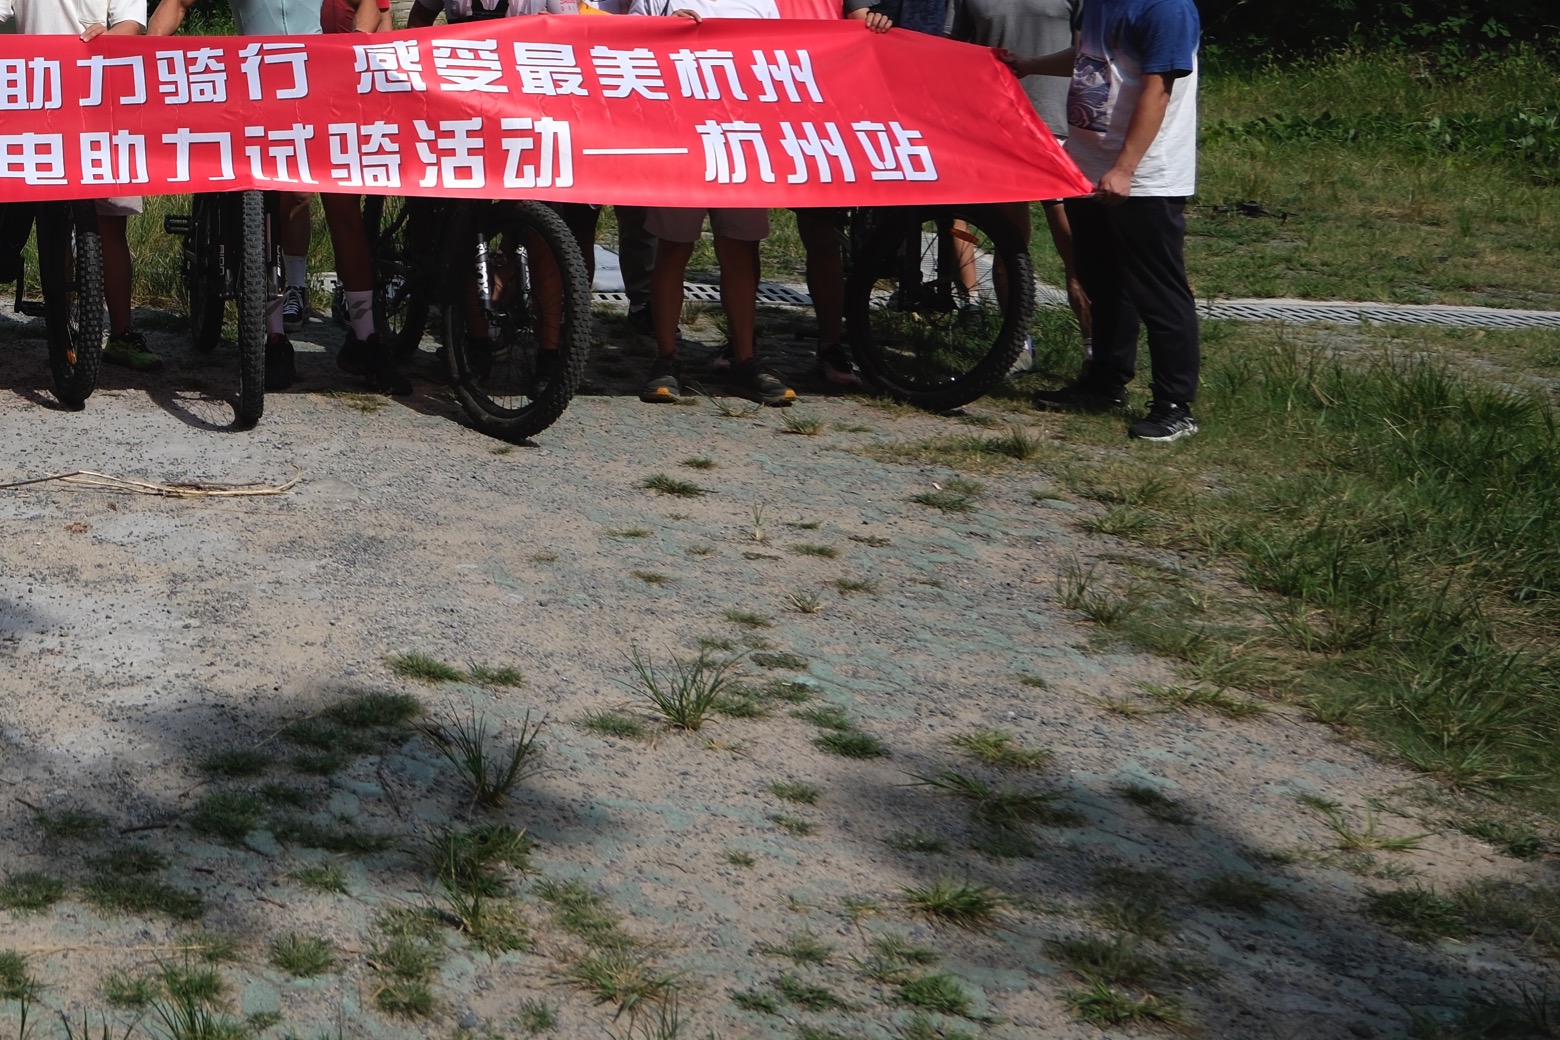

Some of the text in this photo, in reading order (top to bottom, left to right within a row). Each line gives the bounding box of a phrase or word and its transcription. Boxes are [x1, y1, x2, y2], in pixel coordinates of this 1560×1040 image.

[354, 38, 824, 104] 感受最美杭州
